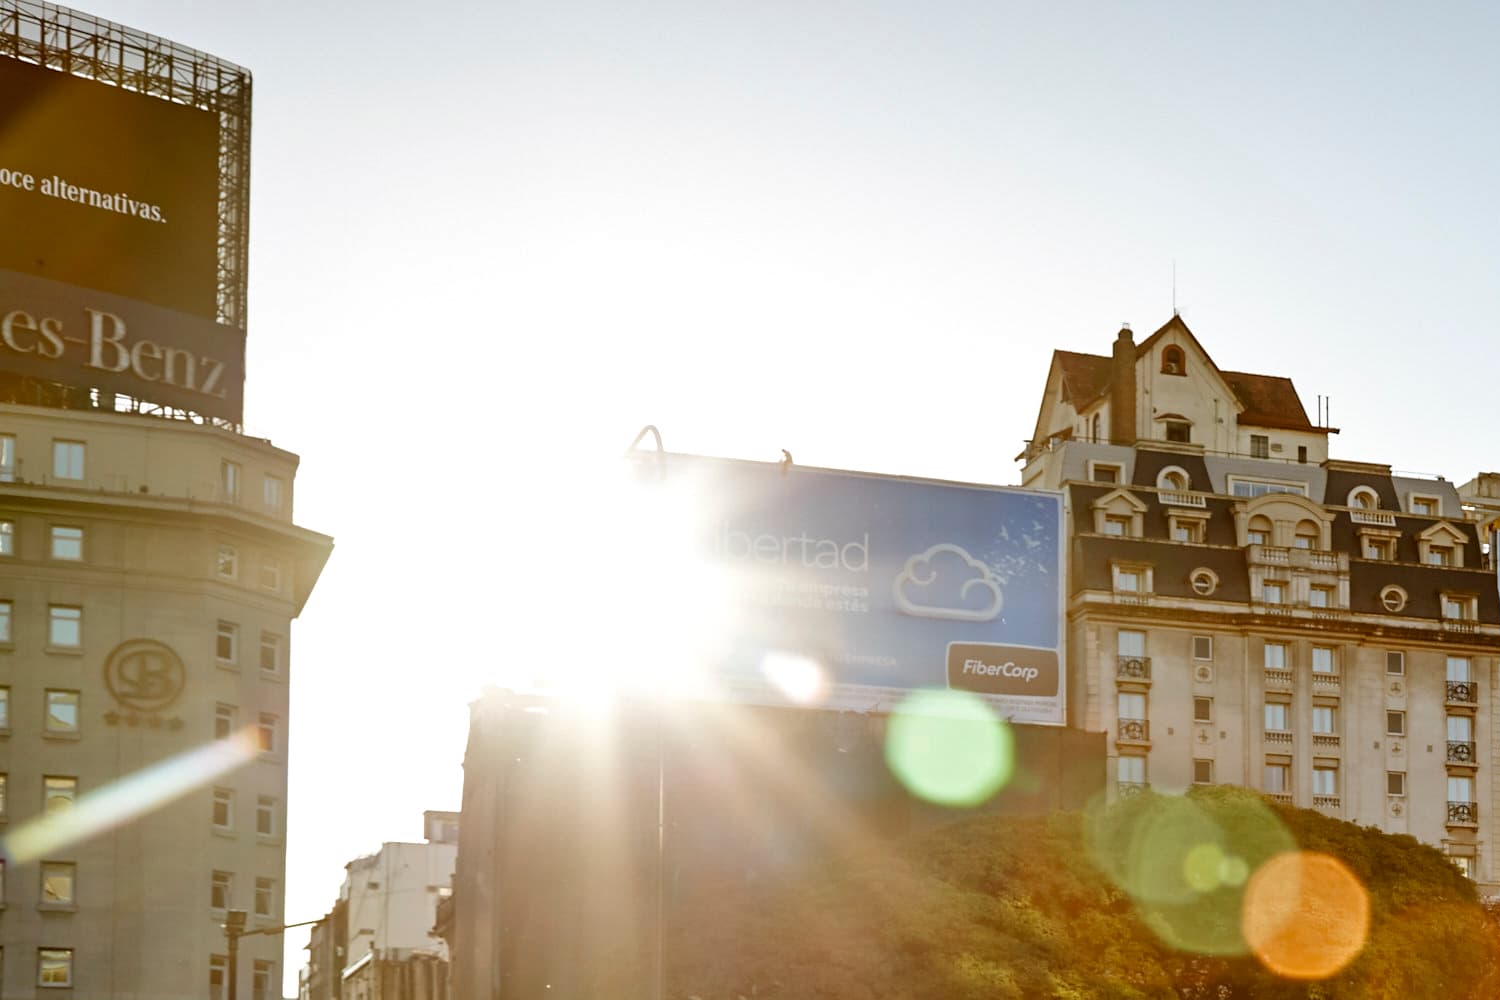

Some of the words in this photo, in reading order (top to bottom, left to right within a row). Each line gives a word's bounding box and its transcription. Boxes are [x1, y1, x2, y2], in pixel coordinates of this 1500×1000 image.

[0, 168, 35, 191] oce
[40, 175, 167, 223] alternativas.
[1, 306, 227, 398] es-Benz
[962, 659, 1039, 682] FiberCorp
